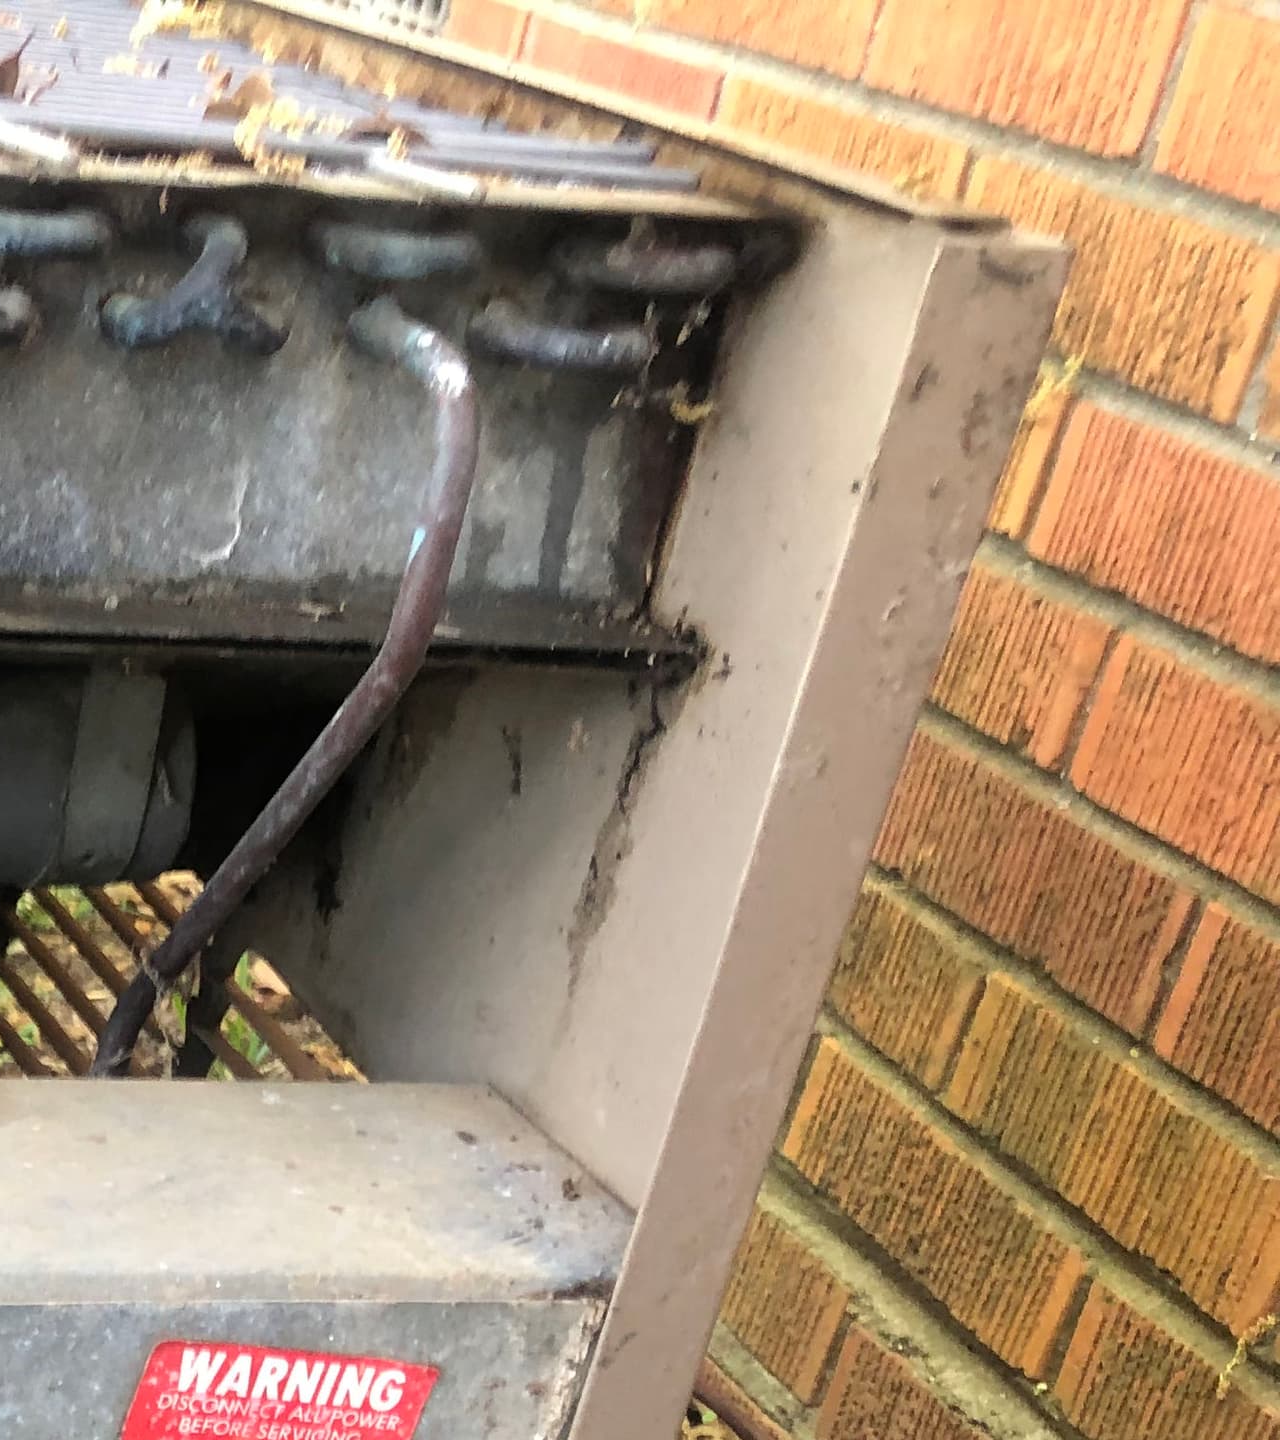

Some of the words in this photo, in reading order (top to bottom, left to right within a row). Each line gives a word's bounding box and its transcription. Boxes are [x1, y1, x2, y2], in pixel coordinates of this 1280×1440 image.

[177, 1347, 406, 1411] WARNING
[156, 1393, 285, 1421] DISCONNECT
[289, 1403, 329, 1425] ALL
[329, 1407, 400, 1431] POWER
[178, 1417, 252, 1439] BEFORE
